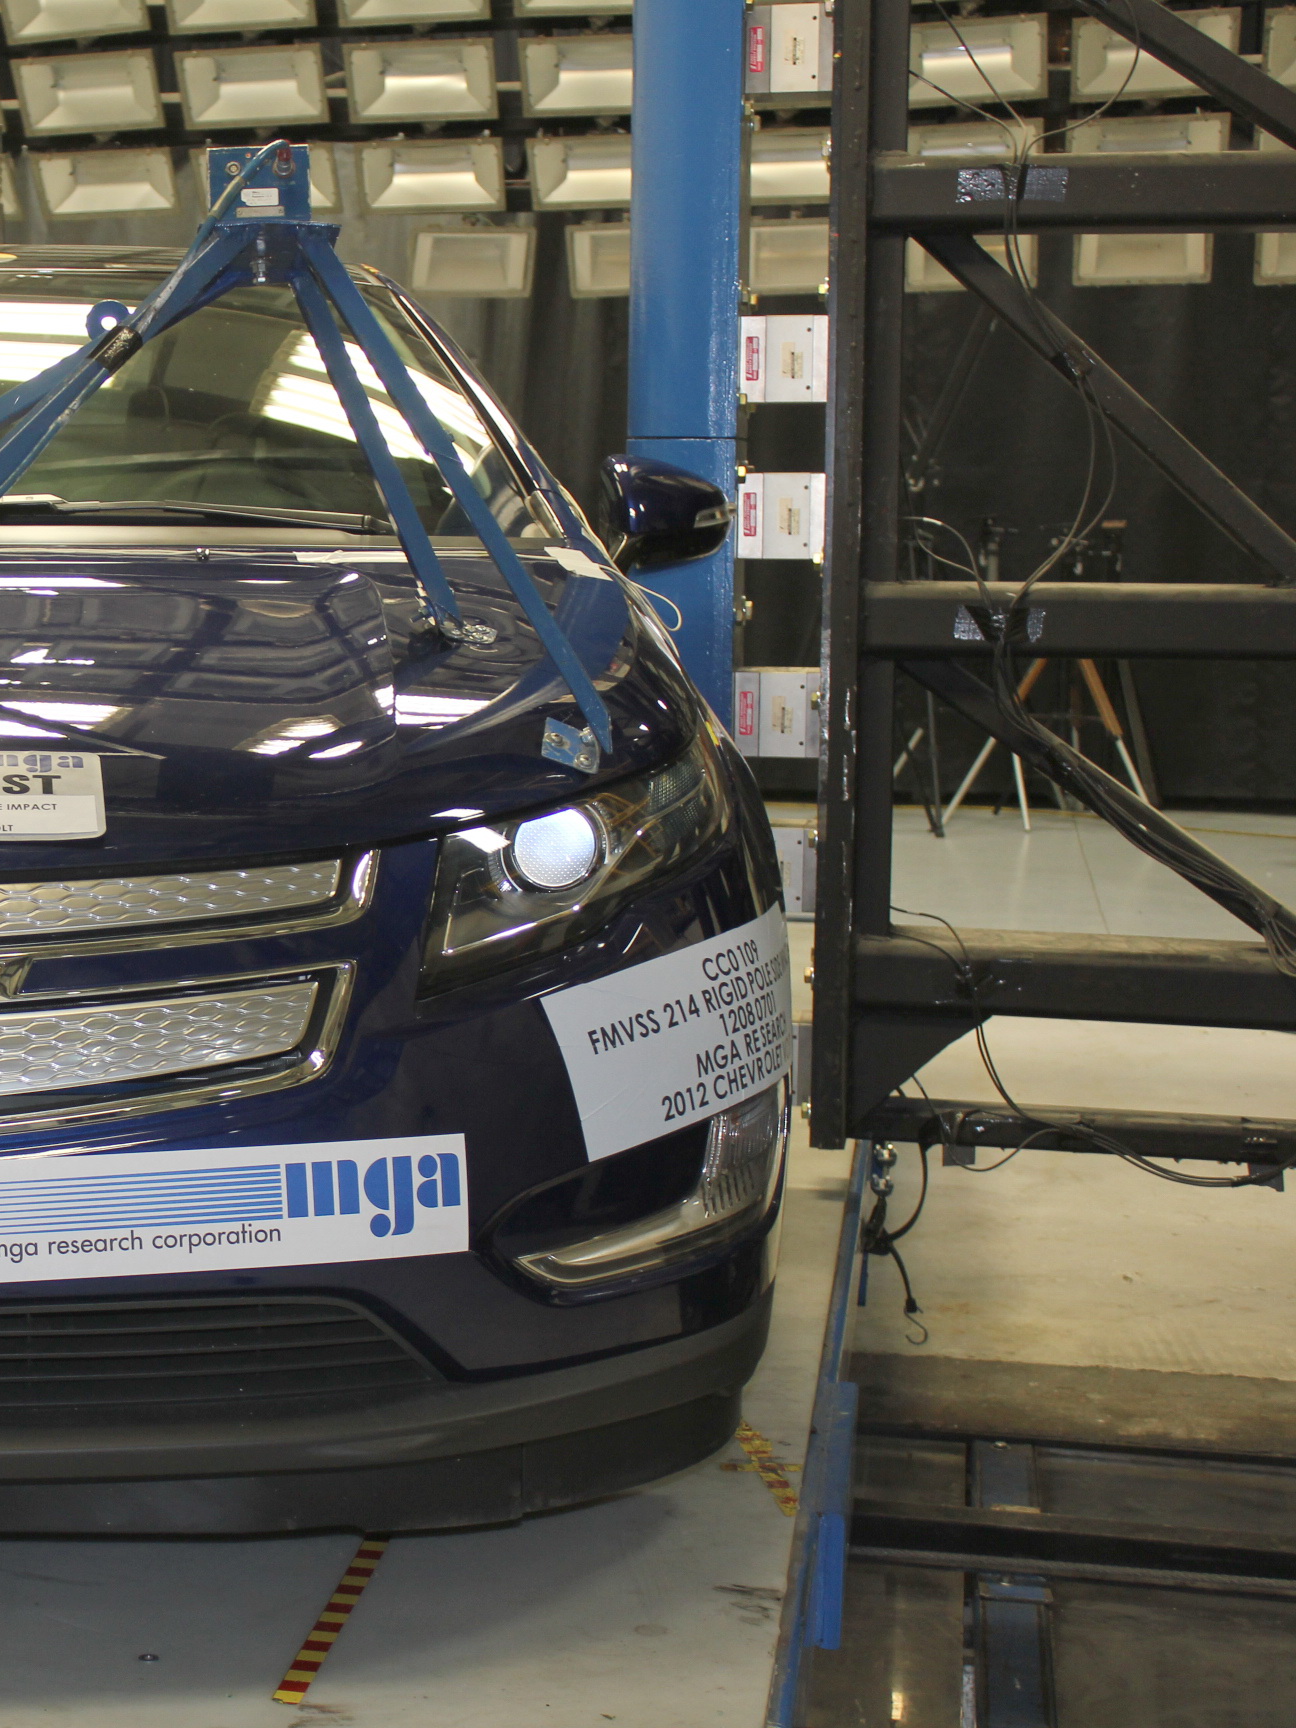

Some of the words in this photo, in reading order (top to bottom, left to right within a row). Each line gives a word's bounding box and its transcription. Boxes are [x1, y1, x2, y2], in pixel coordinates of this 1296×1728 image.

[7, 803, 58, 811] IMPACT
[702, 939, 759, 981] CC0109
[587, 1009, 661, 1055] FMVSS
[663, 994, 701, 1029] 214
[701, 977, 749, 1014] RIGID
[746, 963, 773, 994] POLE
[719, 990, 777, 1036] 12080701
[696, 1039, 742, 1078] MGA
[661, 1082, 710, 1122] 2012
[713, 1043, 784, 1099] CHEVROLET
[285, 1152, 461, 1238] mga
[47, 1229, 144, 1256] research
[152, 1223, 282, 1254] corporation
